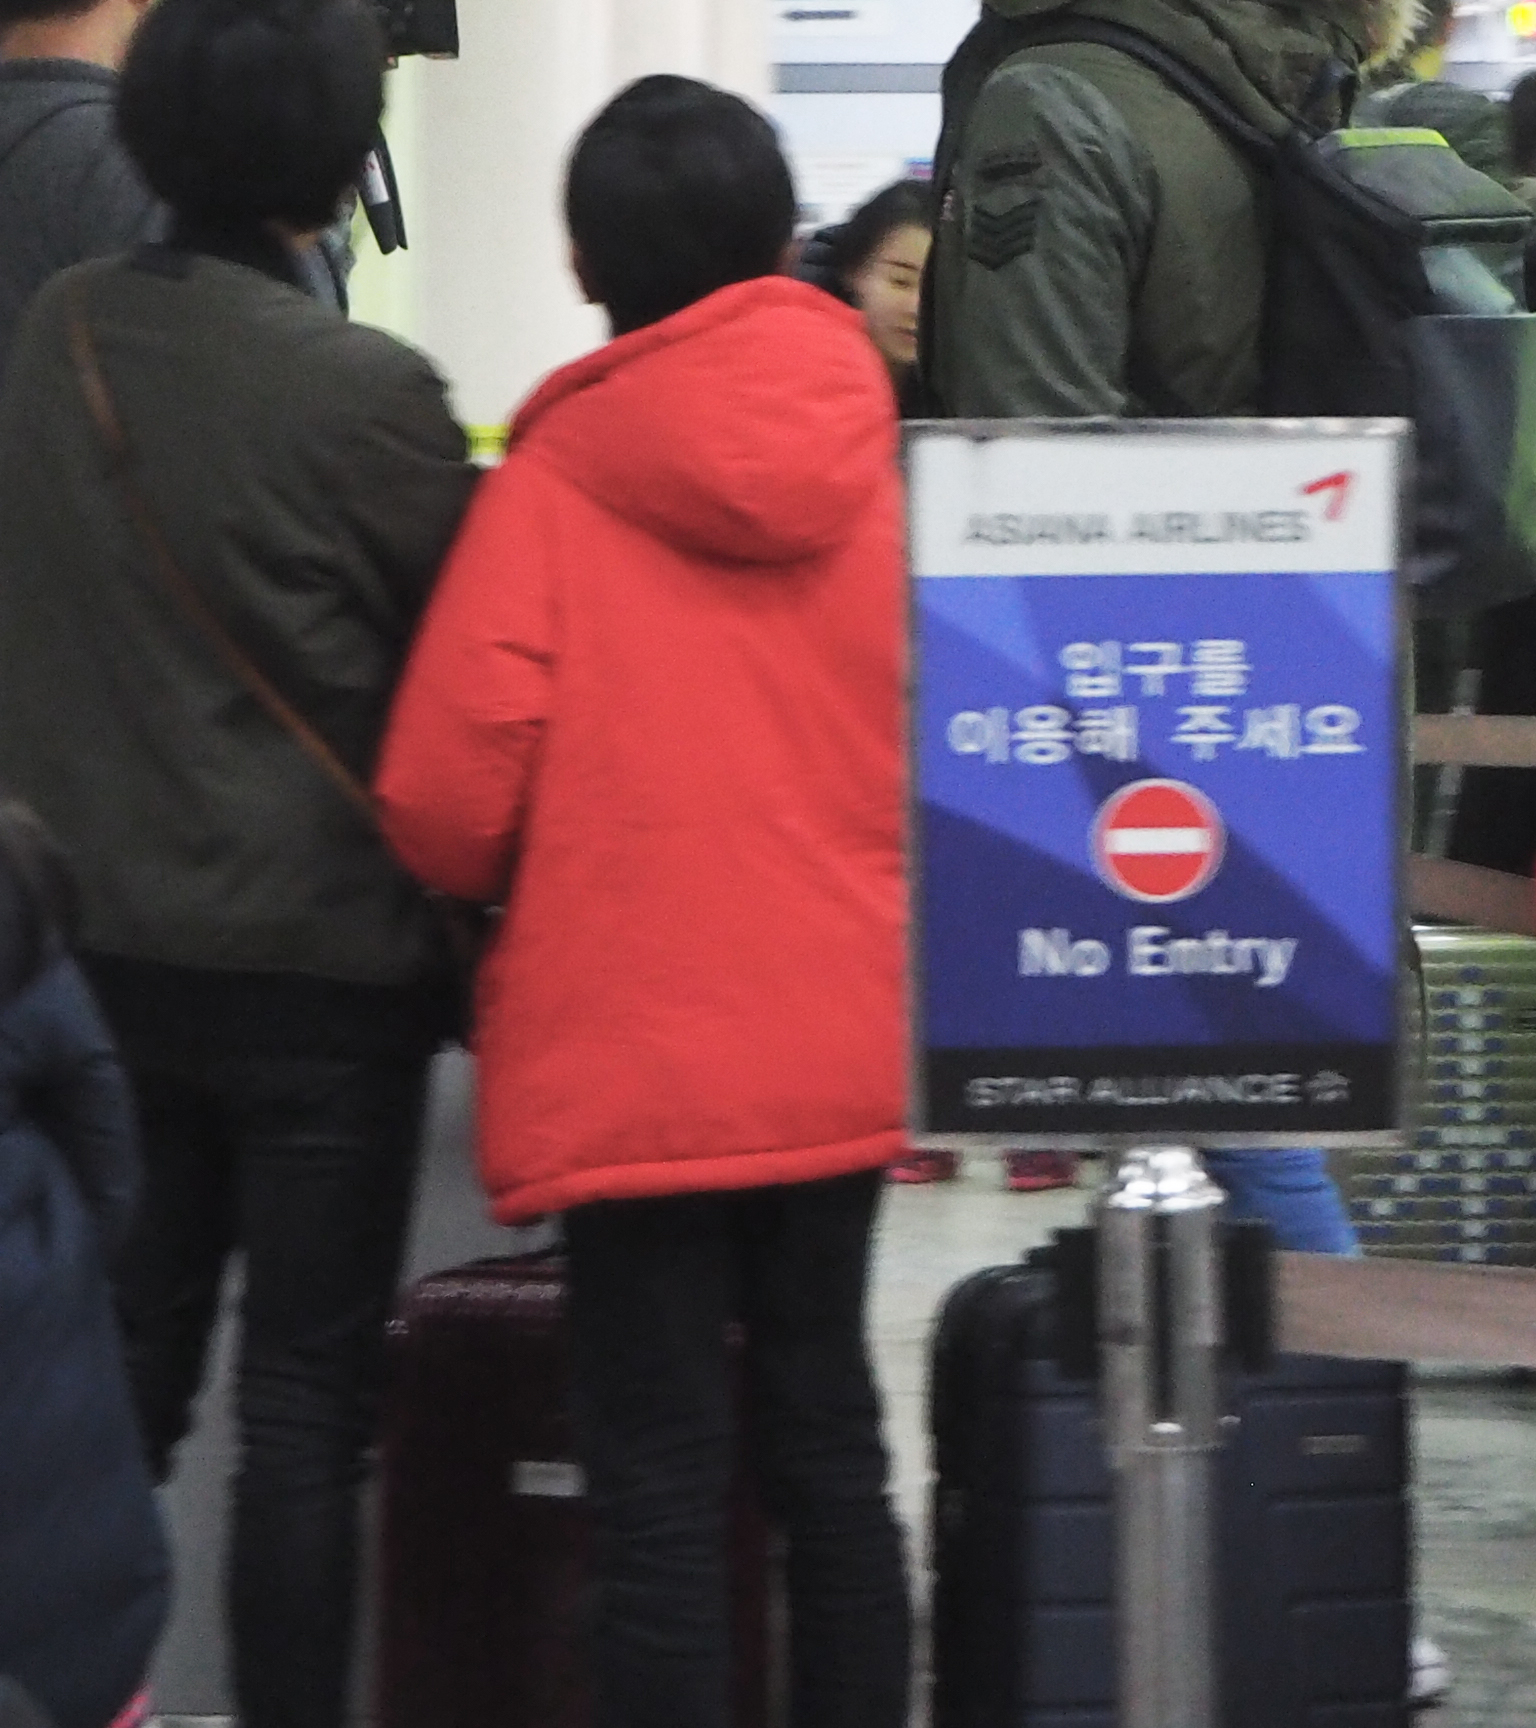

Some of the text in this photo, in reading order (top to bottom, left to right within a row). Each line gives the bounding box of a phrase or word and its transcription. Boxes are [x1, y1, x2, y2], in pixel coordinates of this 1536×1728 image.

[965, 510, 1310, 544] ASIANA AIRLINES
[1060, 639, 1252, 697] 입구를
[948, 703, 1365, 764] 이용해 주세요
[1017, 925, 1298, 987] No Entry
[966, 1073, 1302, 1107] STAR ALLIANCE
